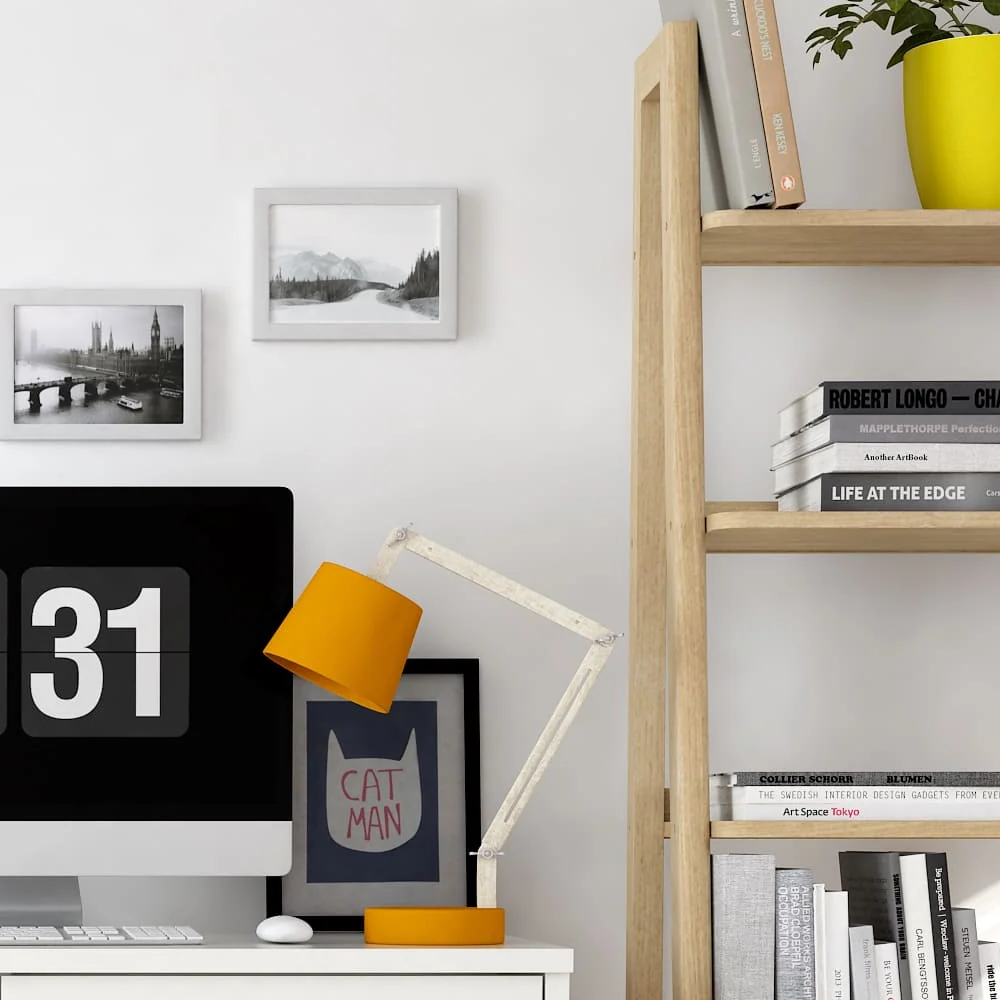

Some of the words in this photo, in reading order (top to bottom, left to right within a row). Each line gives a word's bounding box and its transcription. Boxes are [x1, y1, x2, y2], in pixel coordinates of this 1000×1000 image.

[727, 0, 740, 26] wrin
[760, 41, 773, 61] NEST
[772, 112, 784, 130] KEN
[775, 130, 788, 155] KESEY
[829, 388, 891, 409] ROBERT
[895, 388, 947, 409] LONGO
[859, 423, 949, 434] MAPPLETHORPE
[951, 423, 1000, 434] Perfectio
[864, 453, 895, 462] Another
[896, 453, 928, 462] ArtBook
[832, 486, 863, 500] LIFE
[867, 486, 886, 500] AT
[890, 486, 920, 500] THE
[924, 486, 966, 501] EDGE
[30, 586, 161, 719] 31
[340, 768, 404, 802] CAT
[760, 775, 806, 784] COLLIER
[808, 775, 854, 784] SCHORR
[886, 775, 933, 784] BLUMEN
[759, 790, 775, 799] THE
[780, 790, 819, 799] SWEDISH
[824, 790, 868, 799] INTERIOR
[873, 790, 906, 799] DESIGN
[911, 790, 950, 799] GADGETS
[955, 790, 977, 799] FROM
[982, 790, 1000, 799] EVE
[346, 803, 402, 841] MAN
[783, 807, 800, 816] Art
[801, 807, 829, 818] Space
[831, 807, 860, 818] Tokyo
[935, 867, 943, 877] Be
[790, 886, 800, 916] BRAD
[800, 886, 811, 922] ALLIED
[778, 886, 789, 956] OCCUPATION
[802, 925, 811, 963] WORKS
[915, 928, 924, 951] CARL
[961, 927, 971, 958] STEVEN
[834, 969, 842, 987] 2013
[964, 961, 974, 990] MEISEL
[986, 964, 996, 979] ride
[884, 972, 893, 996] YOUR
